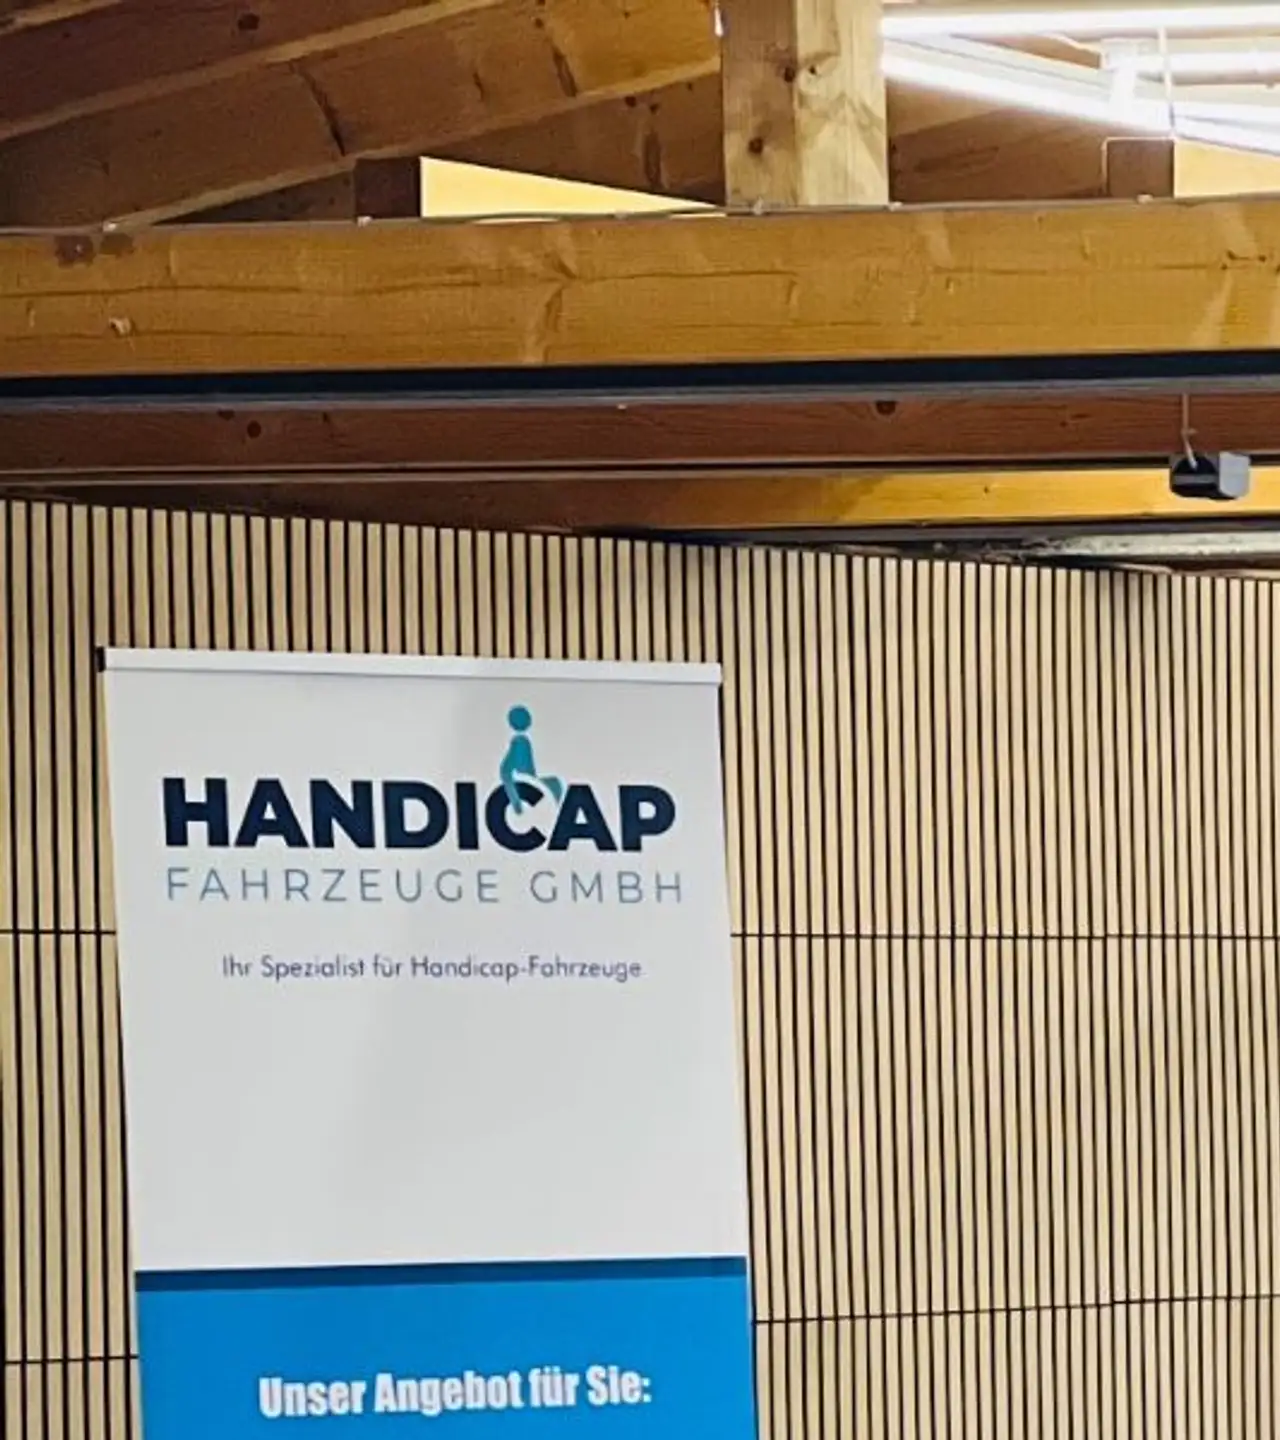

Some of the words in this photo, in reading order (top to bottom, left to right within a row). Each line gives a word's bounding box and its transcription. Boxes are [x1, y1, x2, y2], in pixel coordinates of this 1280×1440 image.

[163, 777, 676, 852] HANDICAP
[166, 866, 500, 904] FAHRZEUGE
[529, 869, 682, 904] GMBH
[222, 954, 253, 977] Ihr
[260, 953, 365, 984] Spezialist
[372, 953, 403, 979] für
[409, 954, 642, 984] Handicap-Fahrzeuge
[259, 1377, 367, 1418] Unser
[374, 1370, 525, 1417] Angebot
[528, 1366, 580, 1408] für
